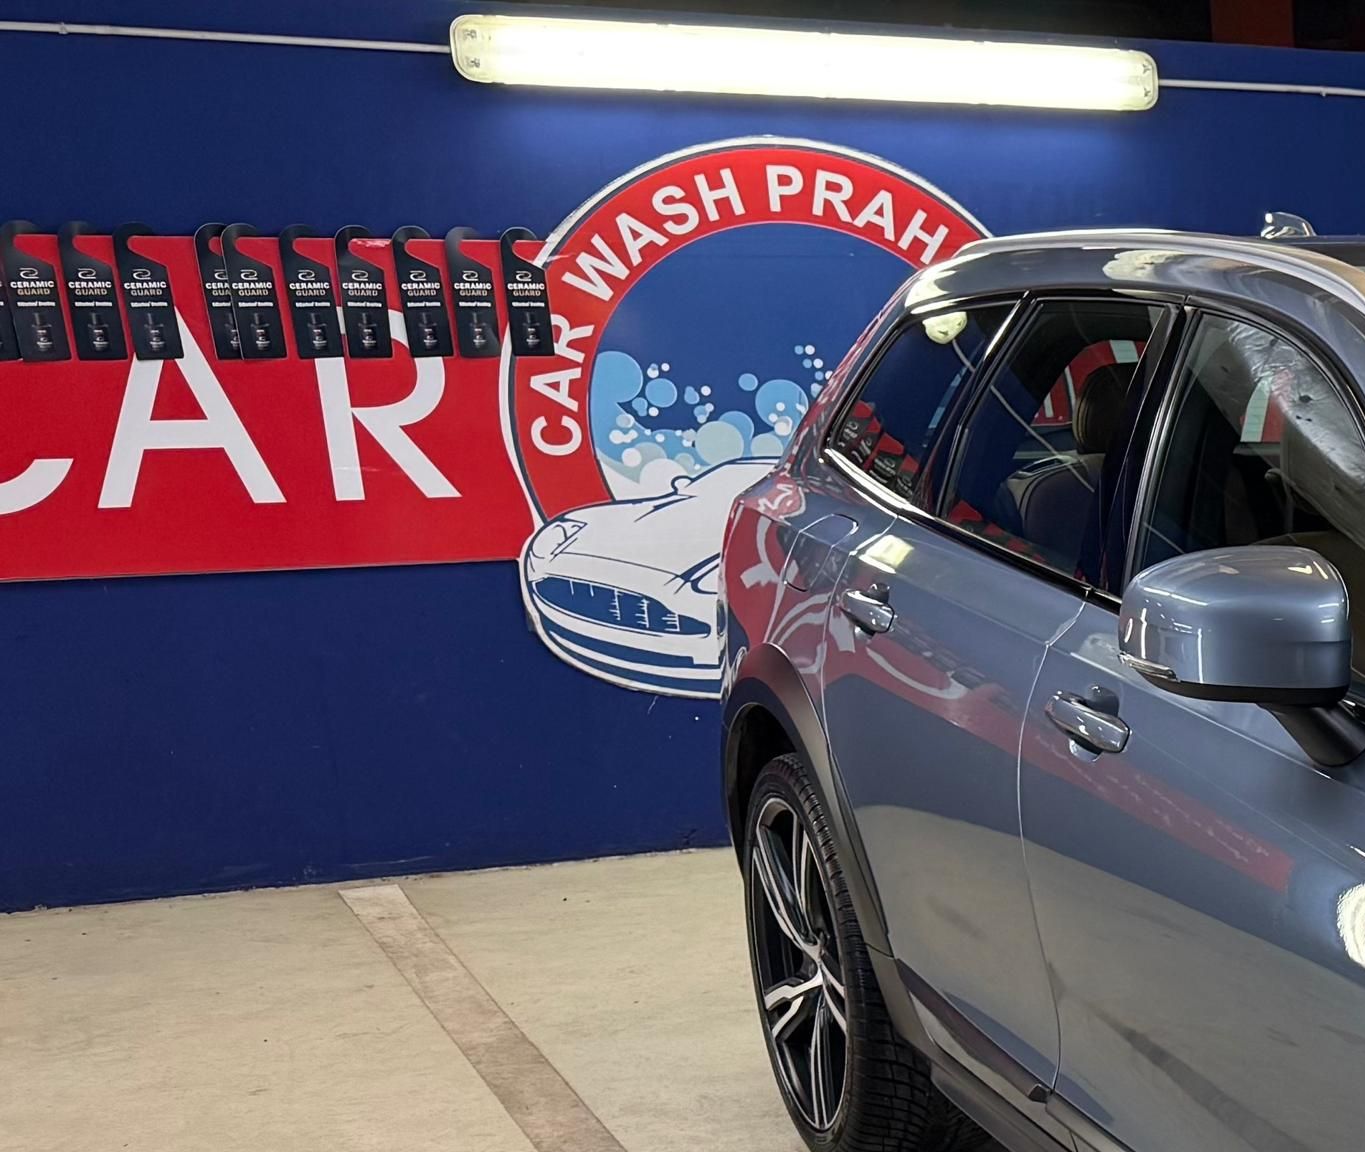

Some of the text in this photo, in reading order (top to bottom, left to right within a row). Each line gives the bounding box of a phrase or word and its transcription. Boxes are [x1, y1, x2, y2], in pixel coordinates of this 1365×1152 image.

[10, 280, 55, 289] CERAMIC
[68, 280, 112, 289] CERAMIC
[124, 281, 167, 290] CERAMIC
[205, 281, 230, 290] CERA
[232, 281, 273, 290] CERAMIC
[289, 281, 330, 290] CERAMIC
[342, 281, 383, 290] CERAMIC
[401, 281, 440, 290] CERAMIC
[453, 282, 492, 290] CERAMIC
[507, 282, 545, 291] CERAMIC
[17, 287, 51, 296] GUARD
[75, 287, 108, 296] GUARD
[130, 288, 163, 296] GUARD
[212, 288, 232, 296] GUA
[238, 288, 269, 296] GUARD
[295, 289, 326, 297] GUARD
[348, 289, 378, 297] GUARD
[407, 289, 437, 297] GUARD
[459, 289, 488, 297] GUARD
[513, 289, 542, 297] GUARD
[530, 163, 950, 456] CAR WASH PRAH
[0, 302, 463, 515] AR
